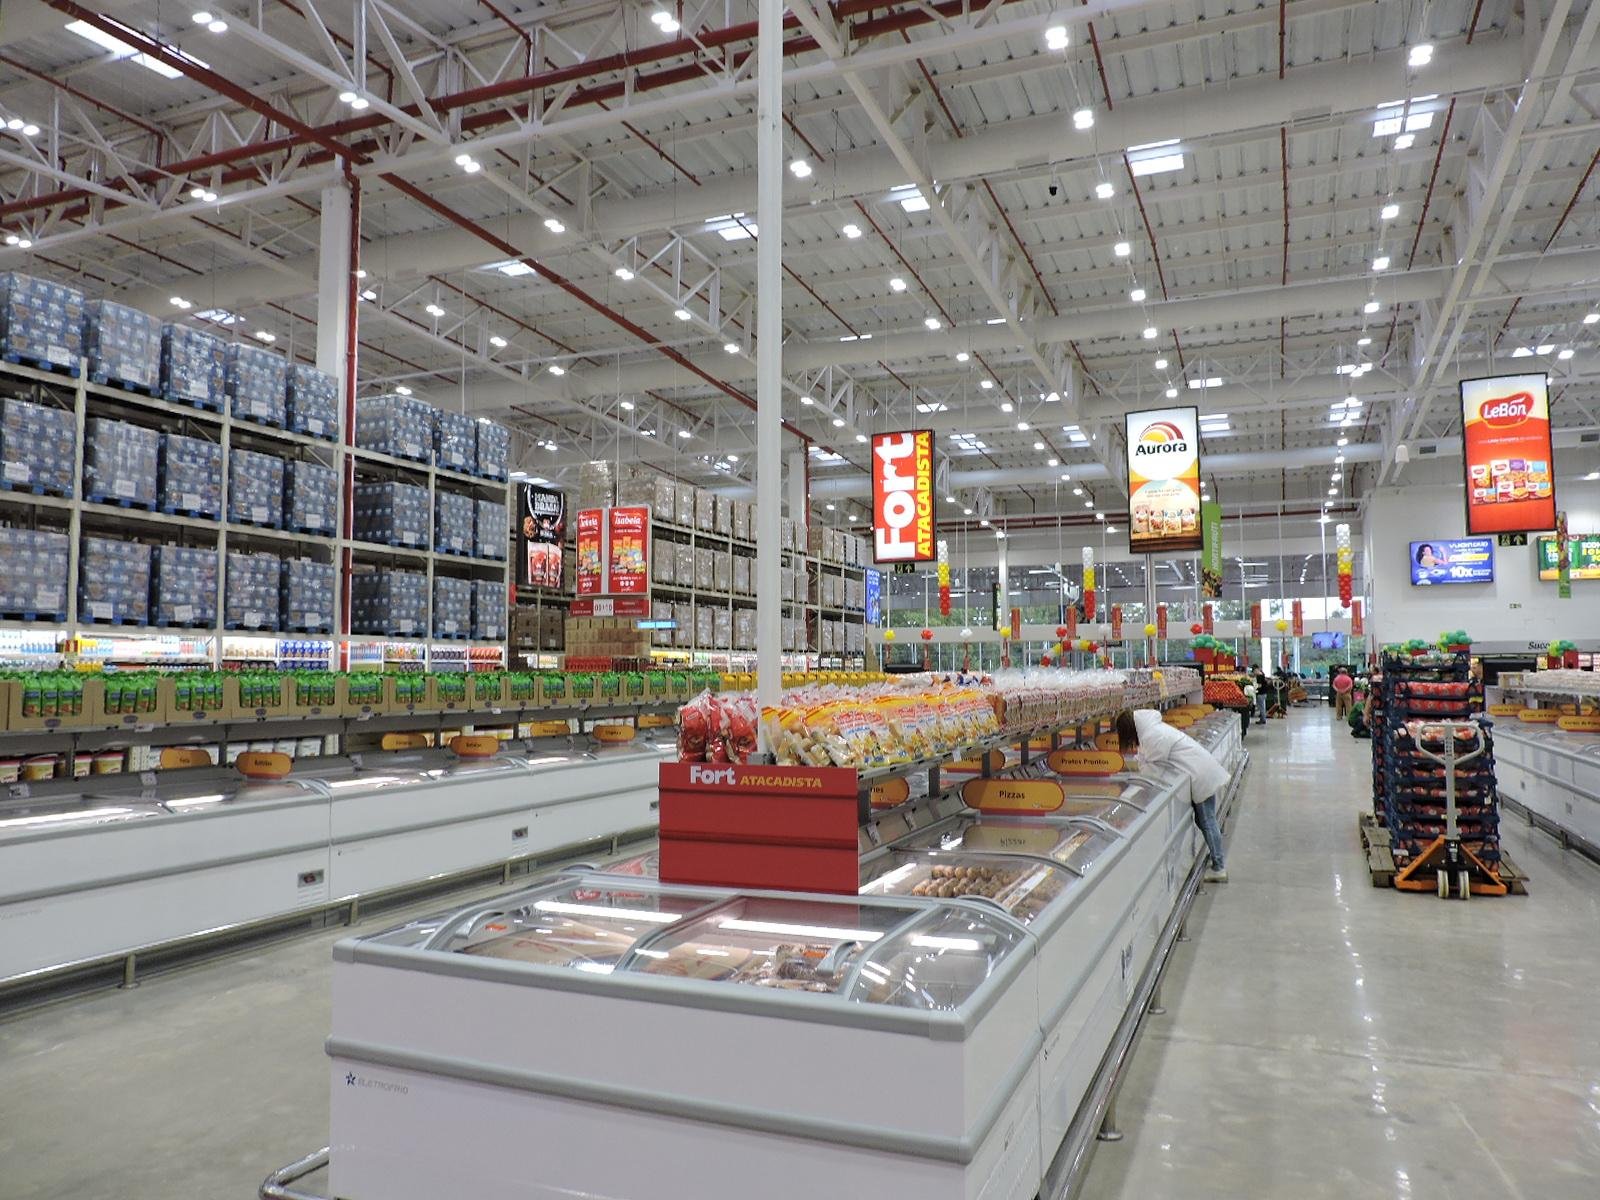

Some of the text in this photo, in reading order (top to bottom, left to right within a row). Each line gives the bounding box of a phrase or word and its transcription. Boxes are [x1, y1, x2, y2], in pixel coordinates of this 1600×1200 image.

[1483, 400, 1527, 419] LeBon
[1135, 442, 1188, 457] Aurora
[875, 432, 916, 560] Fort
[916, 431, 932, 557] ATACADISTA
[689, 765, 823, 789] Fort ATACADISTA
[999, 790, 1026, 800] Pizzas
